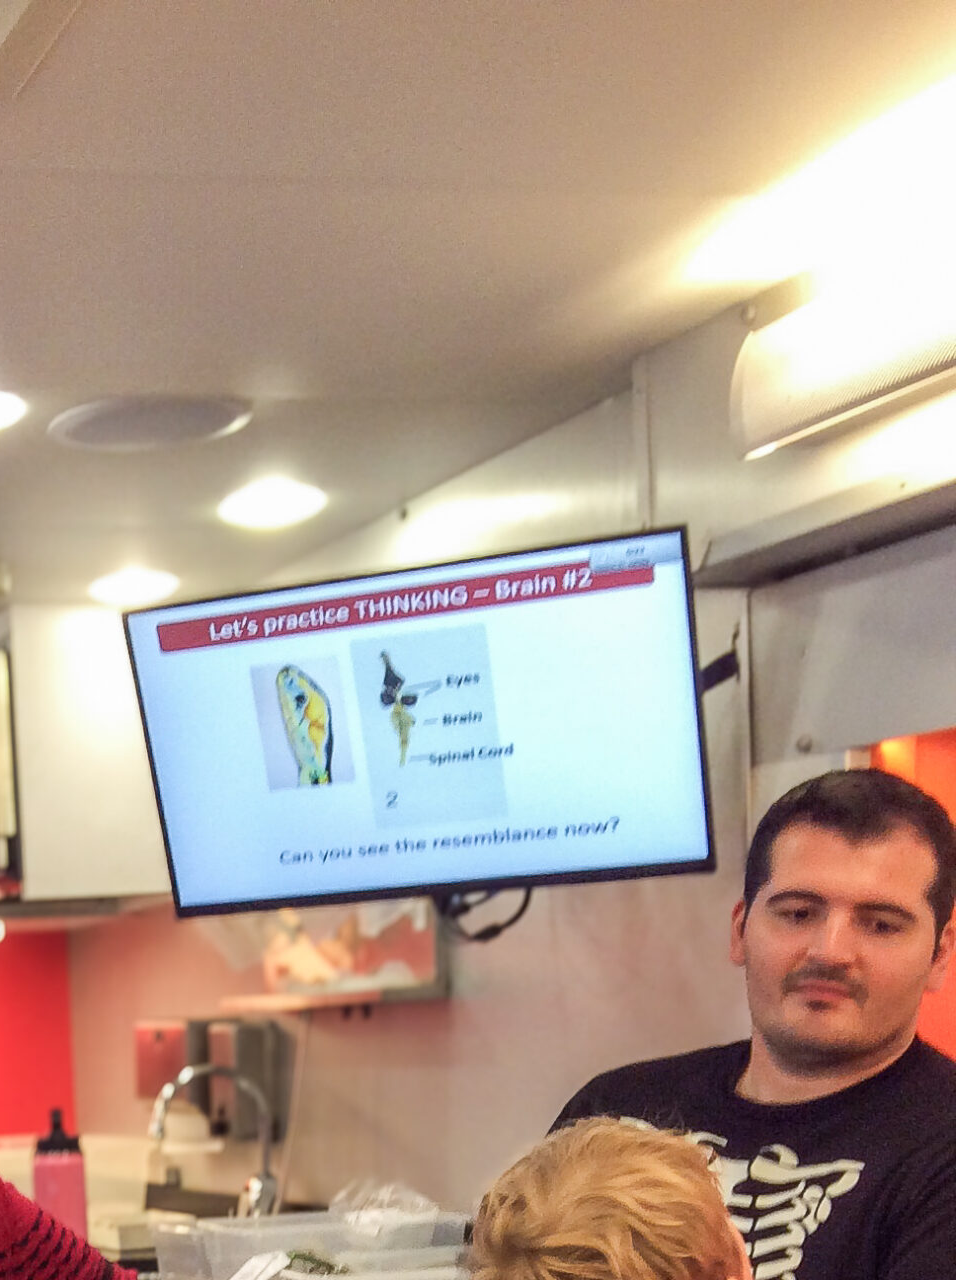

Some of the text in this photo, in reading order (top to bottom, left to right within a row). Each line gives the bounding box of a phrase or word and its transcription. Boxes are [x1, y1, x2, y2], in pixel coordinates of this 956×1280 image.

[209, 615, 258, 641] Let's
[263, 605, 350, 636] practice
[353, 585, 468, 620] THINKING
[495, 573, 556, 600] Brain
[562, 568, 593, 590] #2
[445, 672, 481, 689] Eyes
[442, 711, 483, 727] Brain
[428, 742, 514, 767] Spinal Cord
[279, 816, 620, 865] Can you see the resemblance now?
